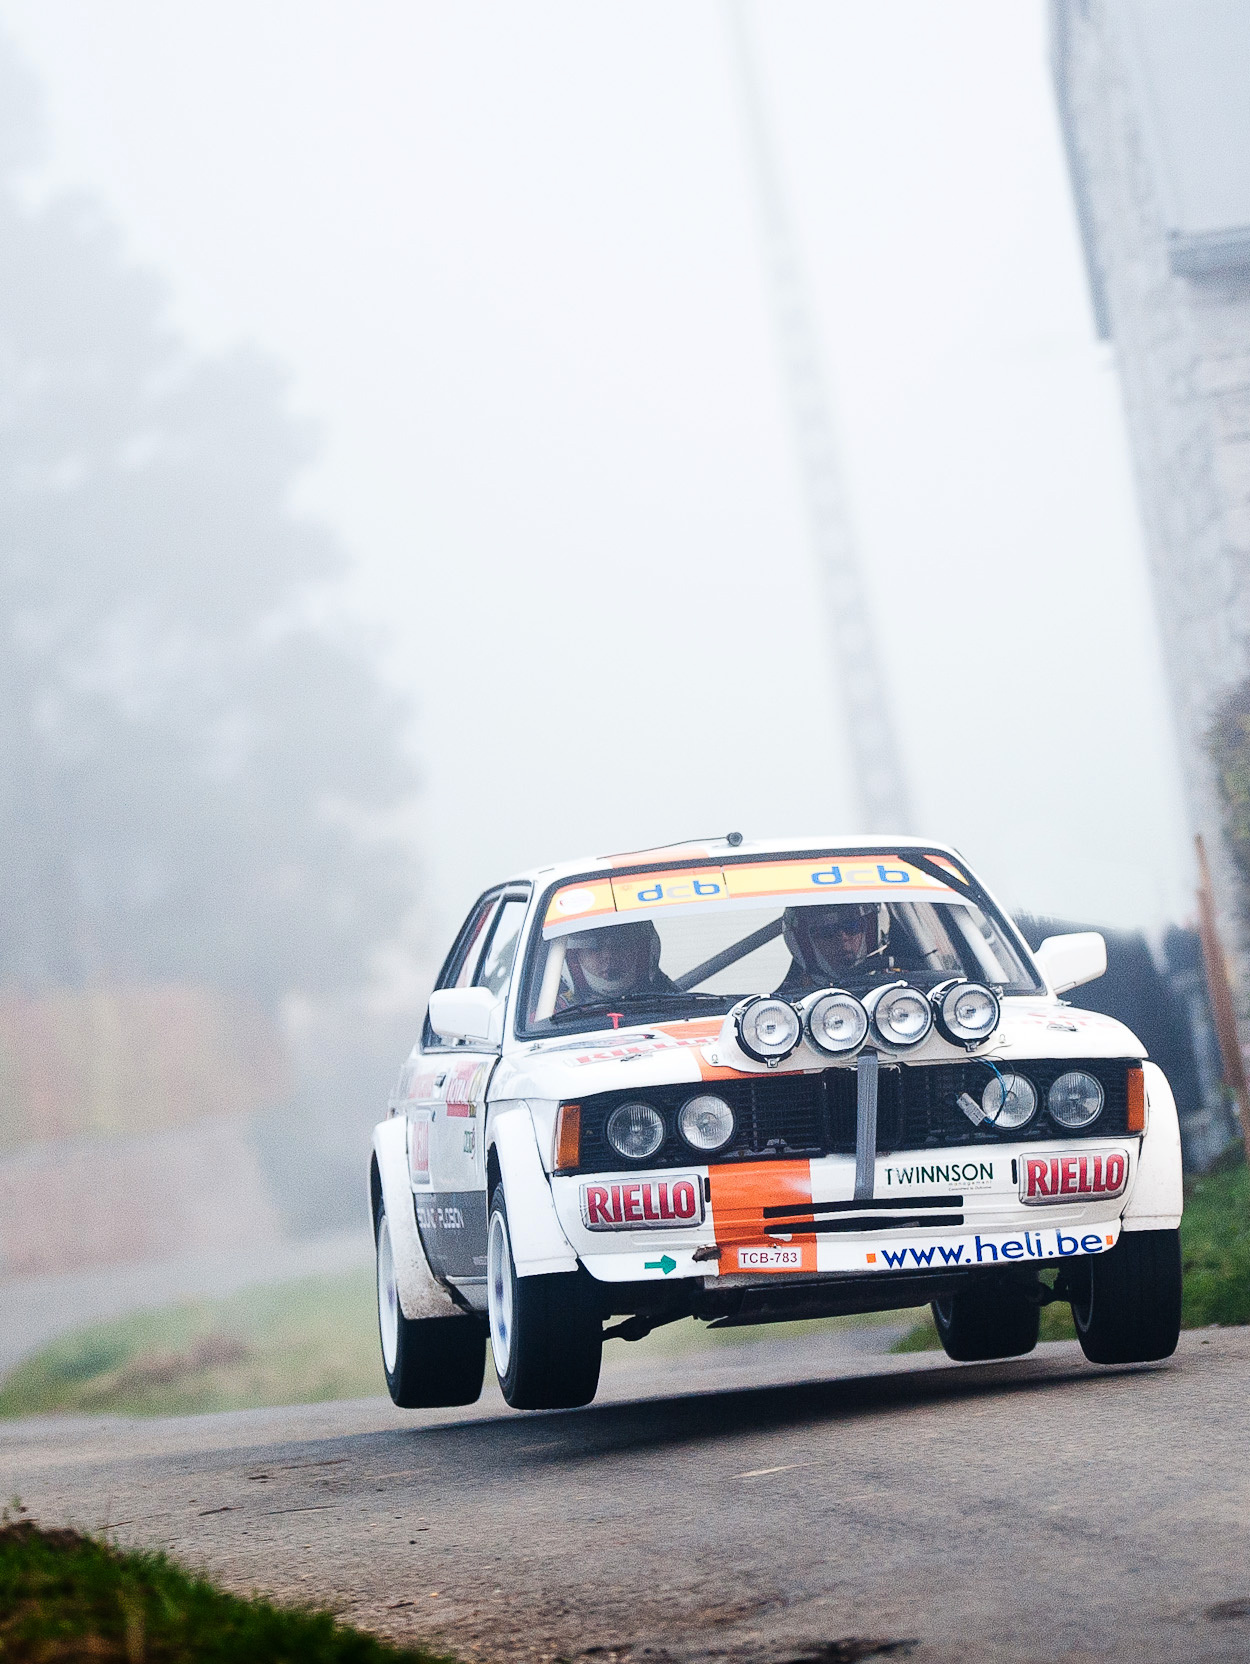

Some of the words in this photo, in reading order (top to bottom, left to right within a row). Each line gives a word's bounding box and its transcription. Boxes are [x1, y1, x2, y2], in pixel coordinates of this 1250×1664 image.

[811, 865, 911, 885] dcb
[637, 880, 720, 902] dcb
[884, 1162, 994, 1186] TWINNSON
[1026, 1153, 1125, 1197] RIELLO
[586, 1180, 697, 1224] RIELLO
[740, 1252, 798, 1265] TCB-783
[880, 1228, 1103, 1269] www.heli.be
